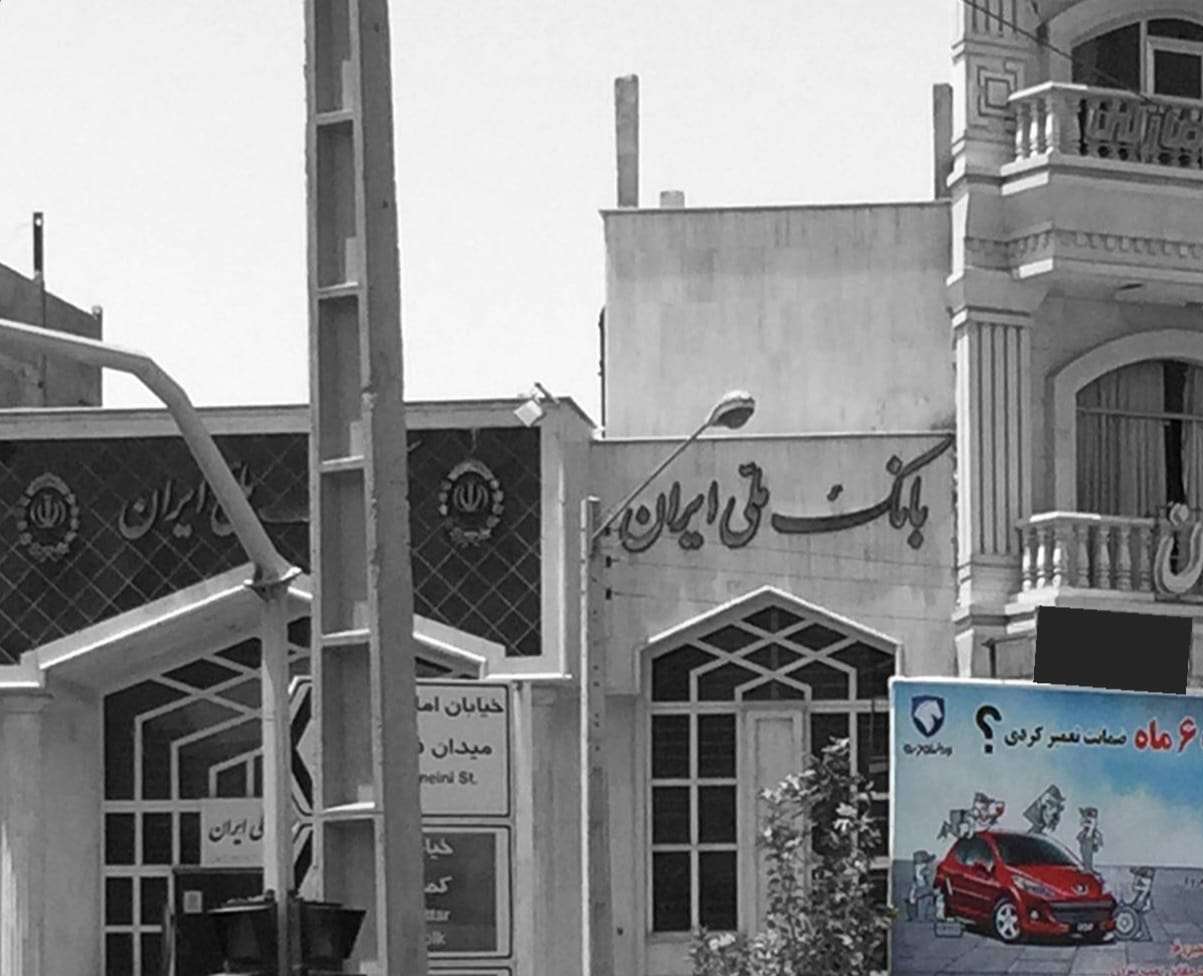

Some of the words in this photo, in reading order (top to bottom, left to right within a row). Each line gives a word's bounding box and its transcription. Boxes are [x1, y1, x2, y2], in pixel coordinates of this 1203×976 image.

[770, 433, 955, 550] بانک
[118, 479, 207, 541] ایران
[619, 479, 719, 554] ایران
[443, 696, 505, 719] خیابان
[430, 736, 494, 760] میدان
[1004, 725, 1045, 749] کردی
[1082, 726, 1128, 747] ضمانت
[1134, 720, 1173, 753] ماه
[1177, 718, 1198, 754] ۶
[207, 815, 249, 847] ایران
